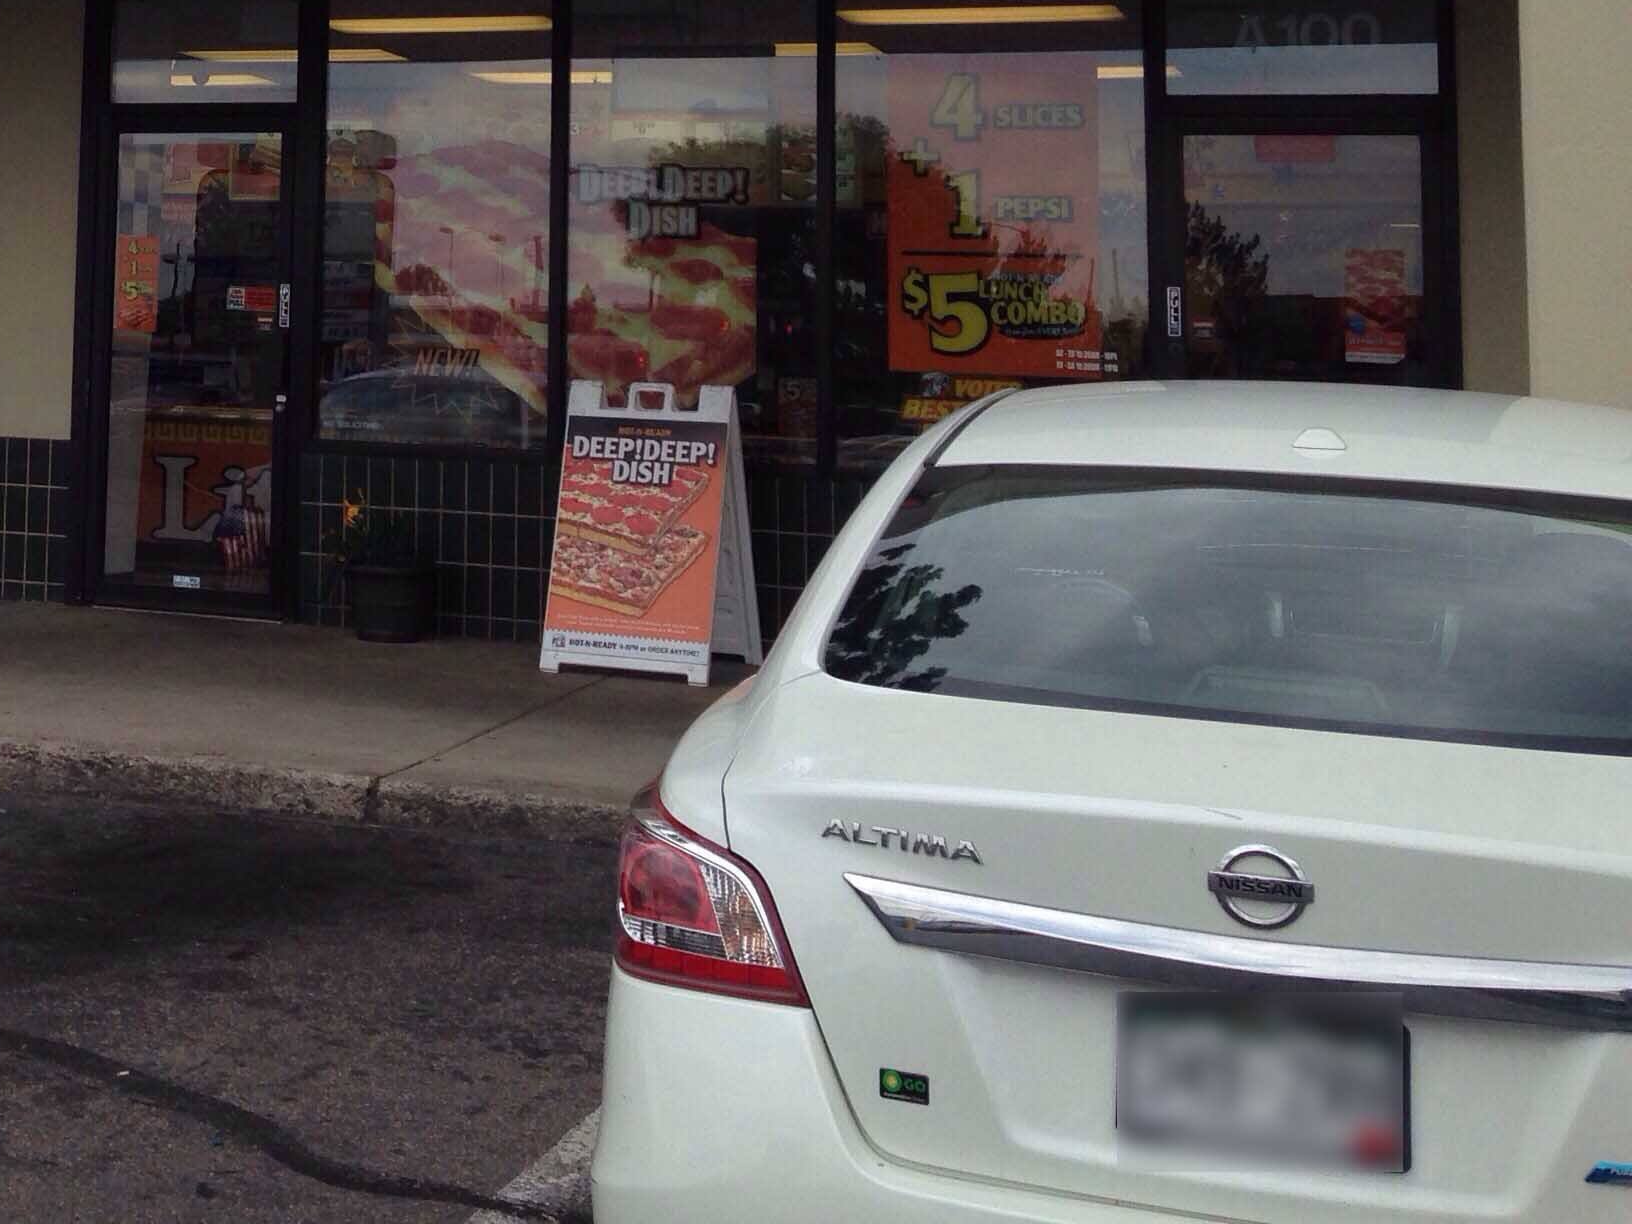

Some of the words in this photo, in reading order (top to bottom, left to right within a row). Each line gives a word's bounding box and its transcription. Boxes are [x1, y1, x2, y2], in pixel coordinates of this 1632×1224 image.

[931, 73, 984, 140] 4
[994, 104, 1083, 130] SLICES
[946, 169, 989, 237] 1
[994, 196, 1073, 221] PEPSI
[628, 201, 699, 239] DISH
[978, 279, 1049, 303] LUNCH
[902, 265, 990, 356] $5
[991, 300, 1086, 325] COMBO
[414, 347, 481, 377] NEW!
[613, 461, 670, 484] DISH
[822, 818, 984, 865] ALTIMA
[1218, 877, 1302, 897] NISSAN
[904, 1079, 926, 1093] GO
